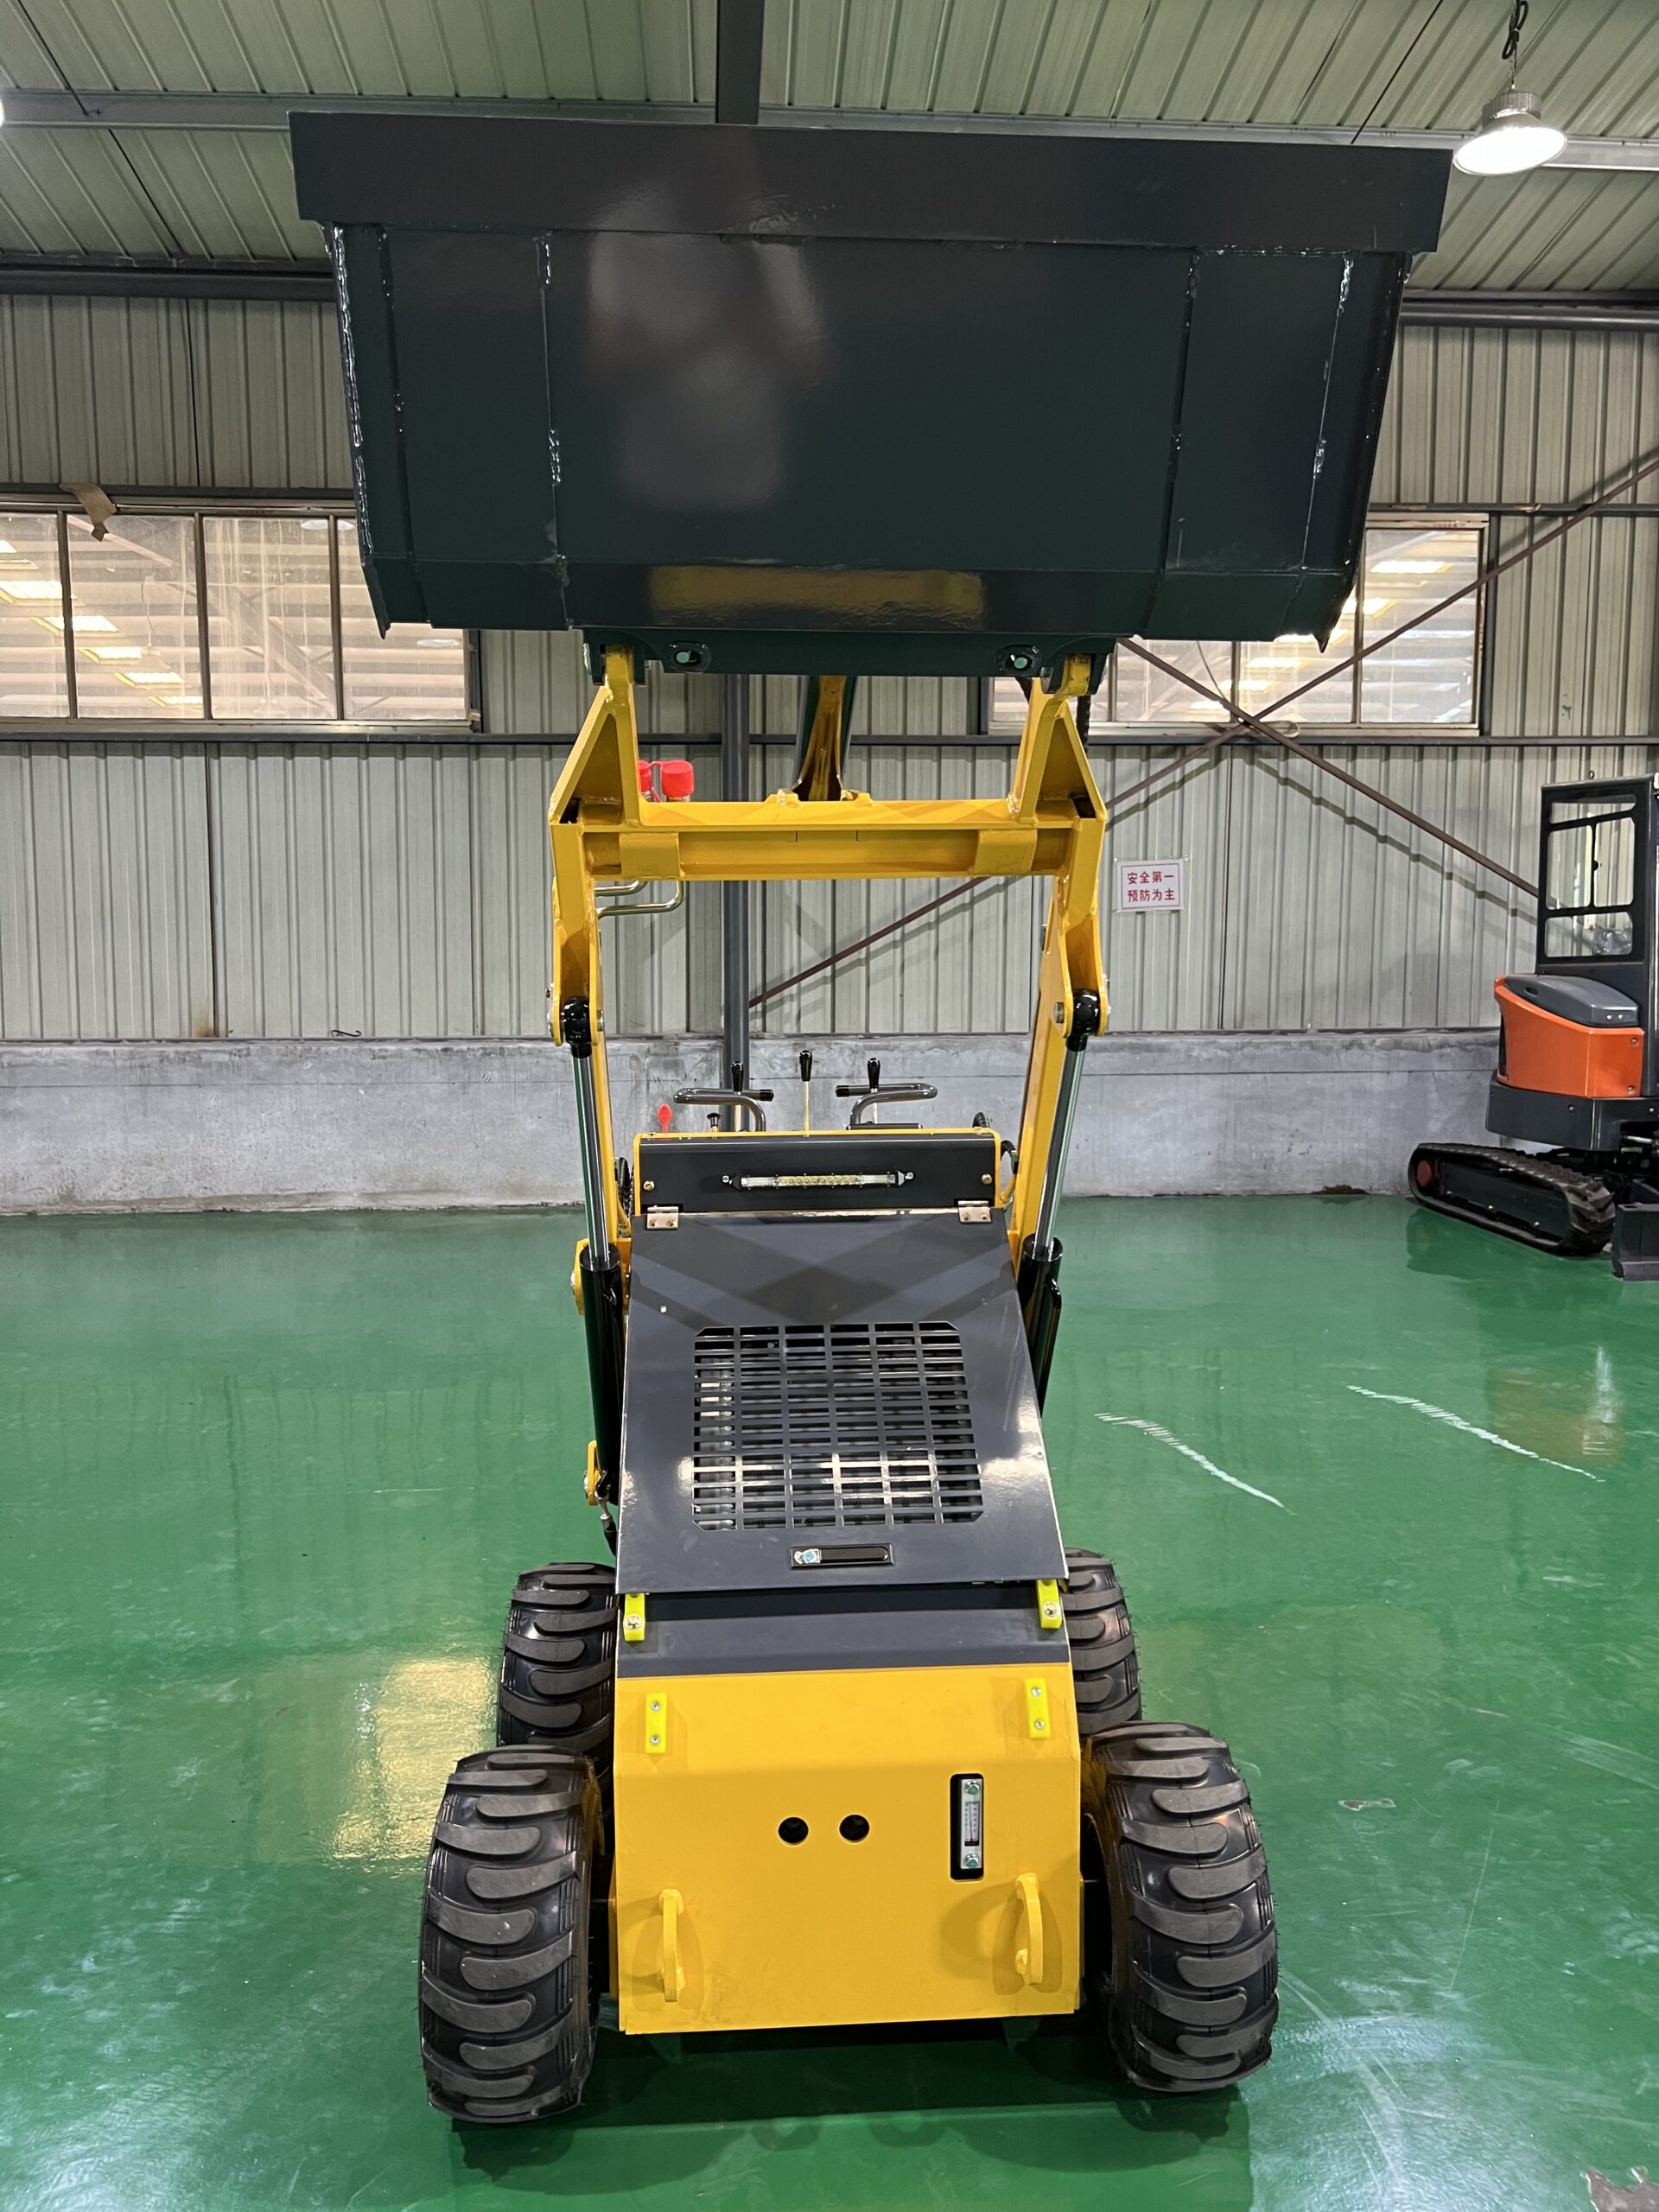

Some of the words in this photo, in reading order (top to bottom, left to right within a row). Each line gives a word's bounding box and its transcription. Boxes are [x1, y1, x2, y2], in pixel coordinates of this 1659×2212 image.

[1128, 871, 1174, 885] 安全第一
[1128, 888, 1175, 902] 预防为主
